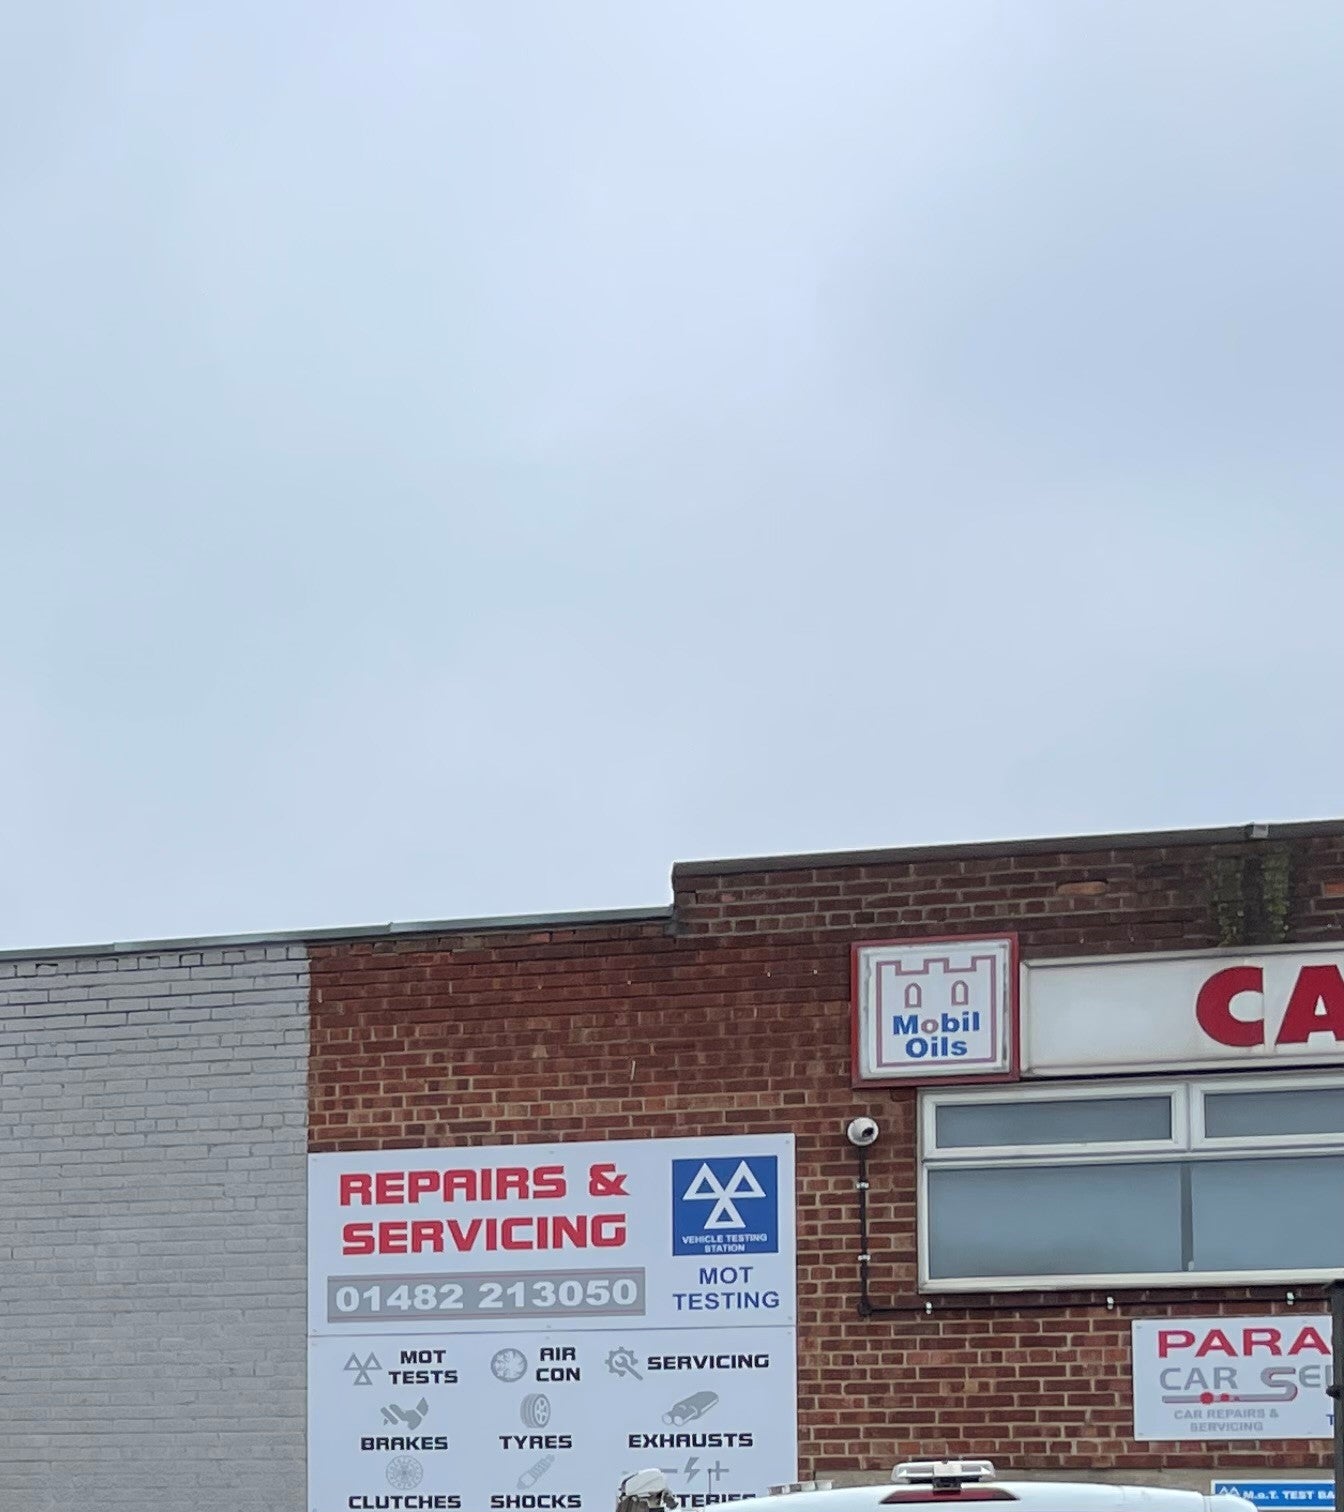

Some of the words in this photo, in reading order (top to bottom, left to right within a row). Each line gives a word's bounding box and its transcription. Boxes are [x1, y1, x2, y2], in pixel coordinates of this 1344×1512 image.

[1196, 964, 1344, 1047] CA
[892, 1011, 980, 1035] Mobil
[905, 1036, 968, 1058] Oils
[340, 1165, 567, 1206] REPAIRS
[589, 1163, 631, 1197] &
[342, 1213, 627, 1256] SERVICING
[682, 1235, 724, 1245] VEHICLE
[727, 1233, 768, 1243] TESTING
[704, 1244, 746, 1254] STATION
[699, 1266, 754, 1285] MOT
[335, 1283, 465, 1313] 01482
[478, 1278, 638, 1309] 213050
[672, 1291, 780, 1311] TESTING
[1158, 1326, 1332, 1358] PARA
[400, 1350, 447, 1364] MOT
[540, 1347, 577, 1361] AIR
[648, 1354, 769, 1370] SERVICING
[388, 1370, 458, 1385] TESTS
[536, 1367, 581, 1382] CON
[1159, 1366, 1238, 1391] CAR
[1174, 1409, 1202, 1420] CAR
[1207, 1408, 1265, 1419] REPAIRS
[1269, 1408, 1279, 1418] &
[1190, 1421, 1263, 1432] SERVICING
[361, 1436, 448, 1451] BRAKES
[499, 1435, 573, 1449] TYRES
[628, 1433, 754, 1448] EXHAUSTS
[348, 1495, 461, 1509] CLUTCHES
[490, 1495, 582, 1509] SHOCKS
[1282, 1491, 1315, 1500] TEST
